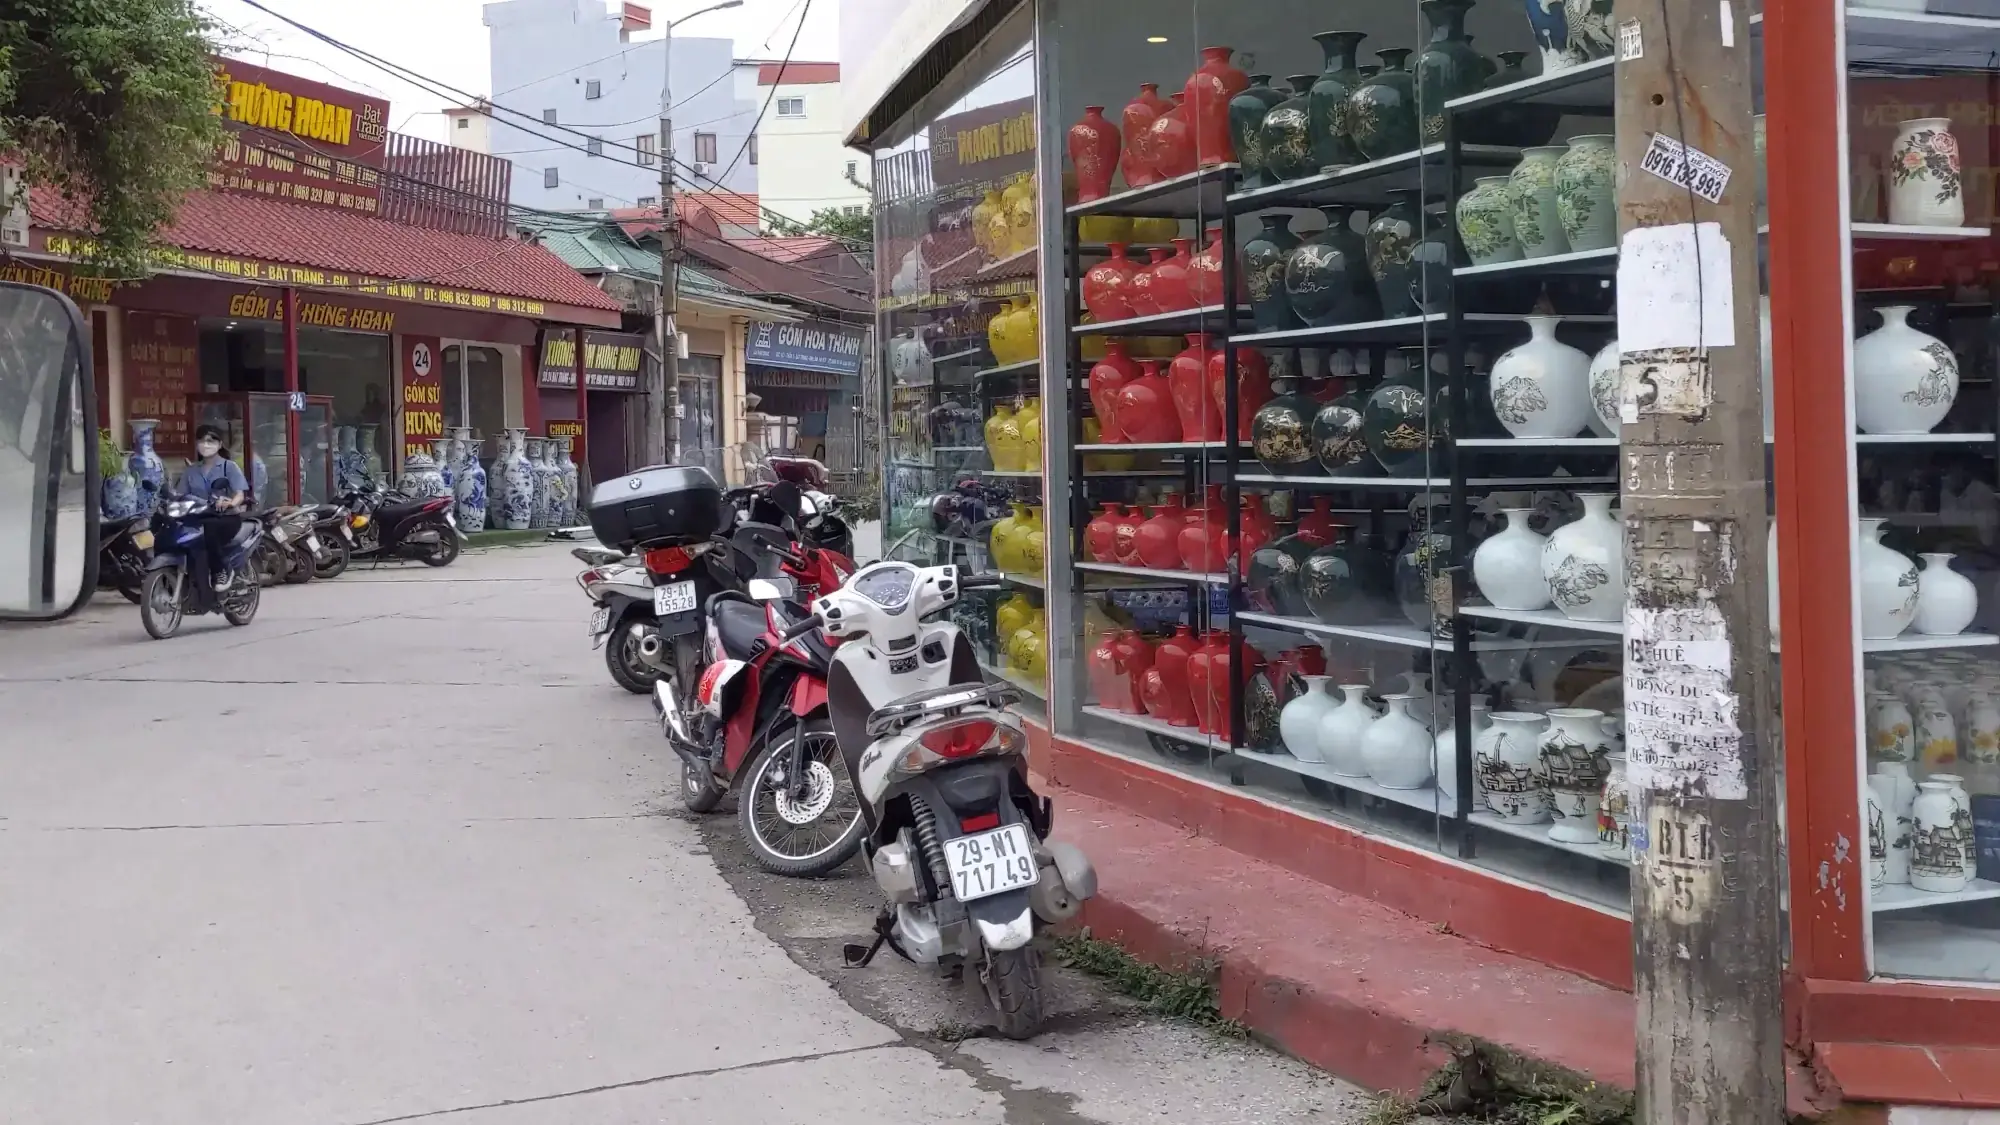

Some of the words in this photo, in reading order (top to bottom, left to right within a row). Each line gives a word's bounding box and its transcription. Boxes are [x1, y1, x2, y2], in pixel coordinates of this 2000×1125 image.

[230, 80, 292, 132] HƯNG
[294, 96, 352, 145] HOAN
[215, 256, 241, 275] GỐM
[244, 260, 260, 278] SỨ
[439, 290, 454, 304] 096
[455, 293, 470, 306] 832
[472, 294, 490, 308] 9889
[512, 300, 526, 313] 312
[229, 286, 269, 319] GỐM
[350, 309, 395, 331] HOAN
[804, 329, 826, 350] HOA
[414, 350, 429, 368] 24
[617, 347, 641, 372] HOAN
[290, 393, 303, 409] 24
[404, 379, 426, 404] GỐM
[428, 382, 441, 404] SỨ
[405, 409, 442, 435] HƯNG
[549, 422, 582, 435] CHUYÊN
[658, 596, 694, 613] 155.28
[660, 583, 689, 603] 29-A1
[957, 830, 1018, 867] 29-N1
[956, 856, 1032, 898] 717.49
